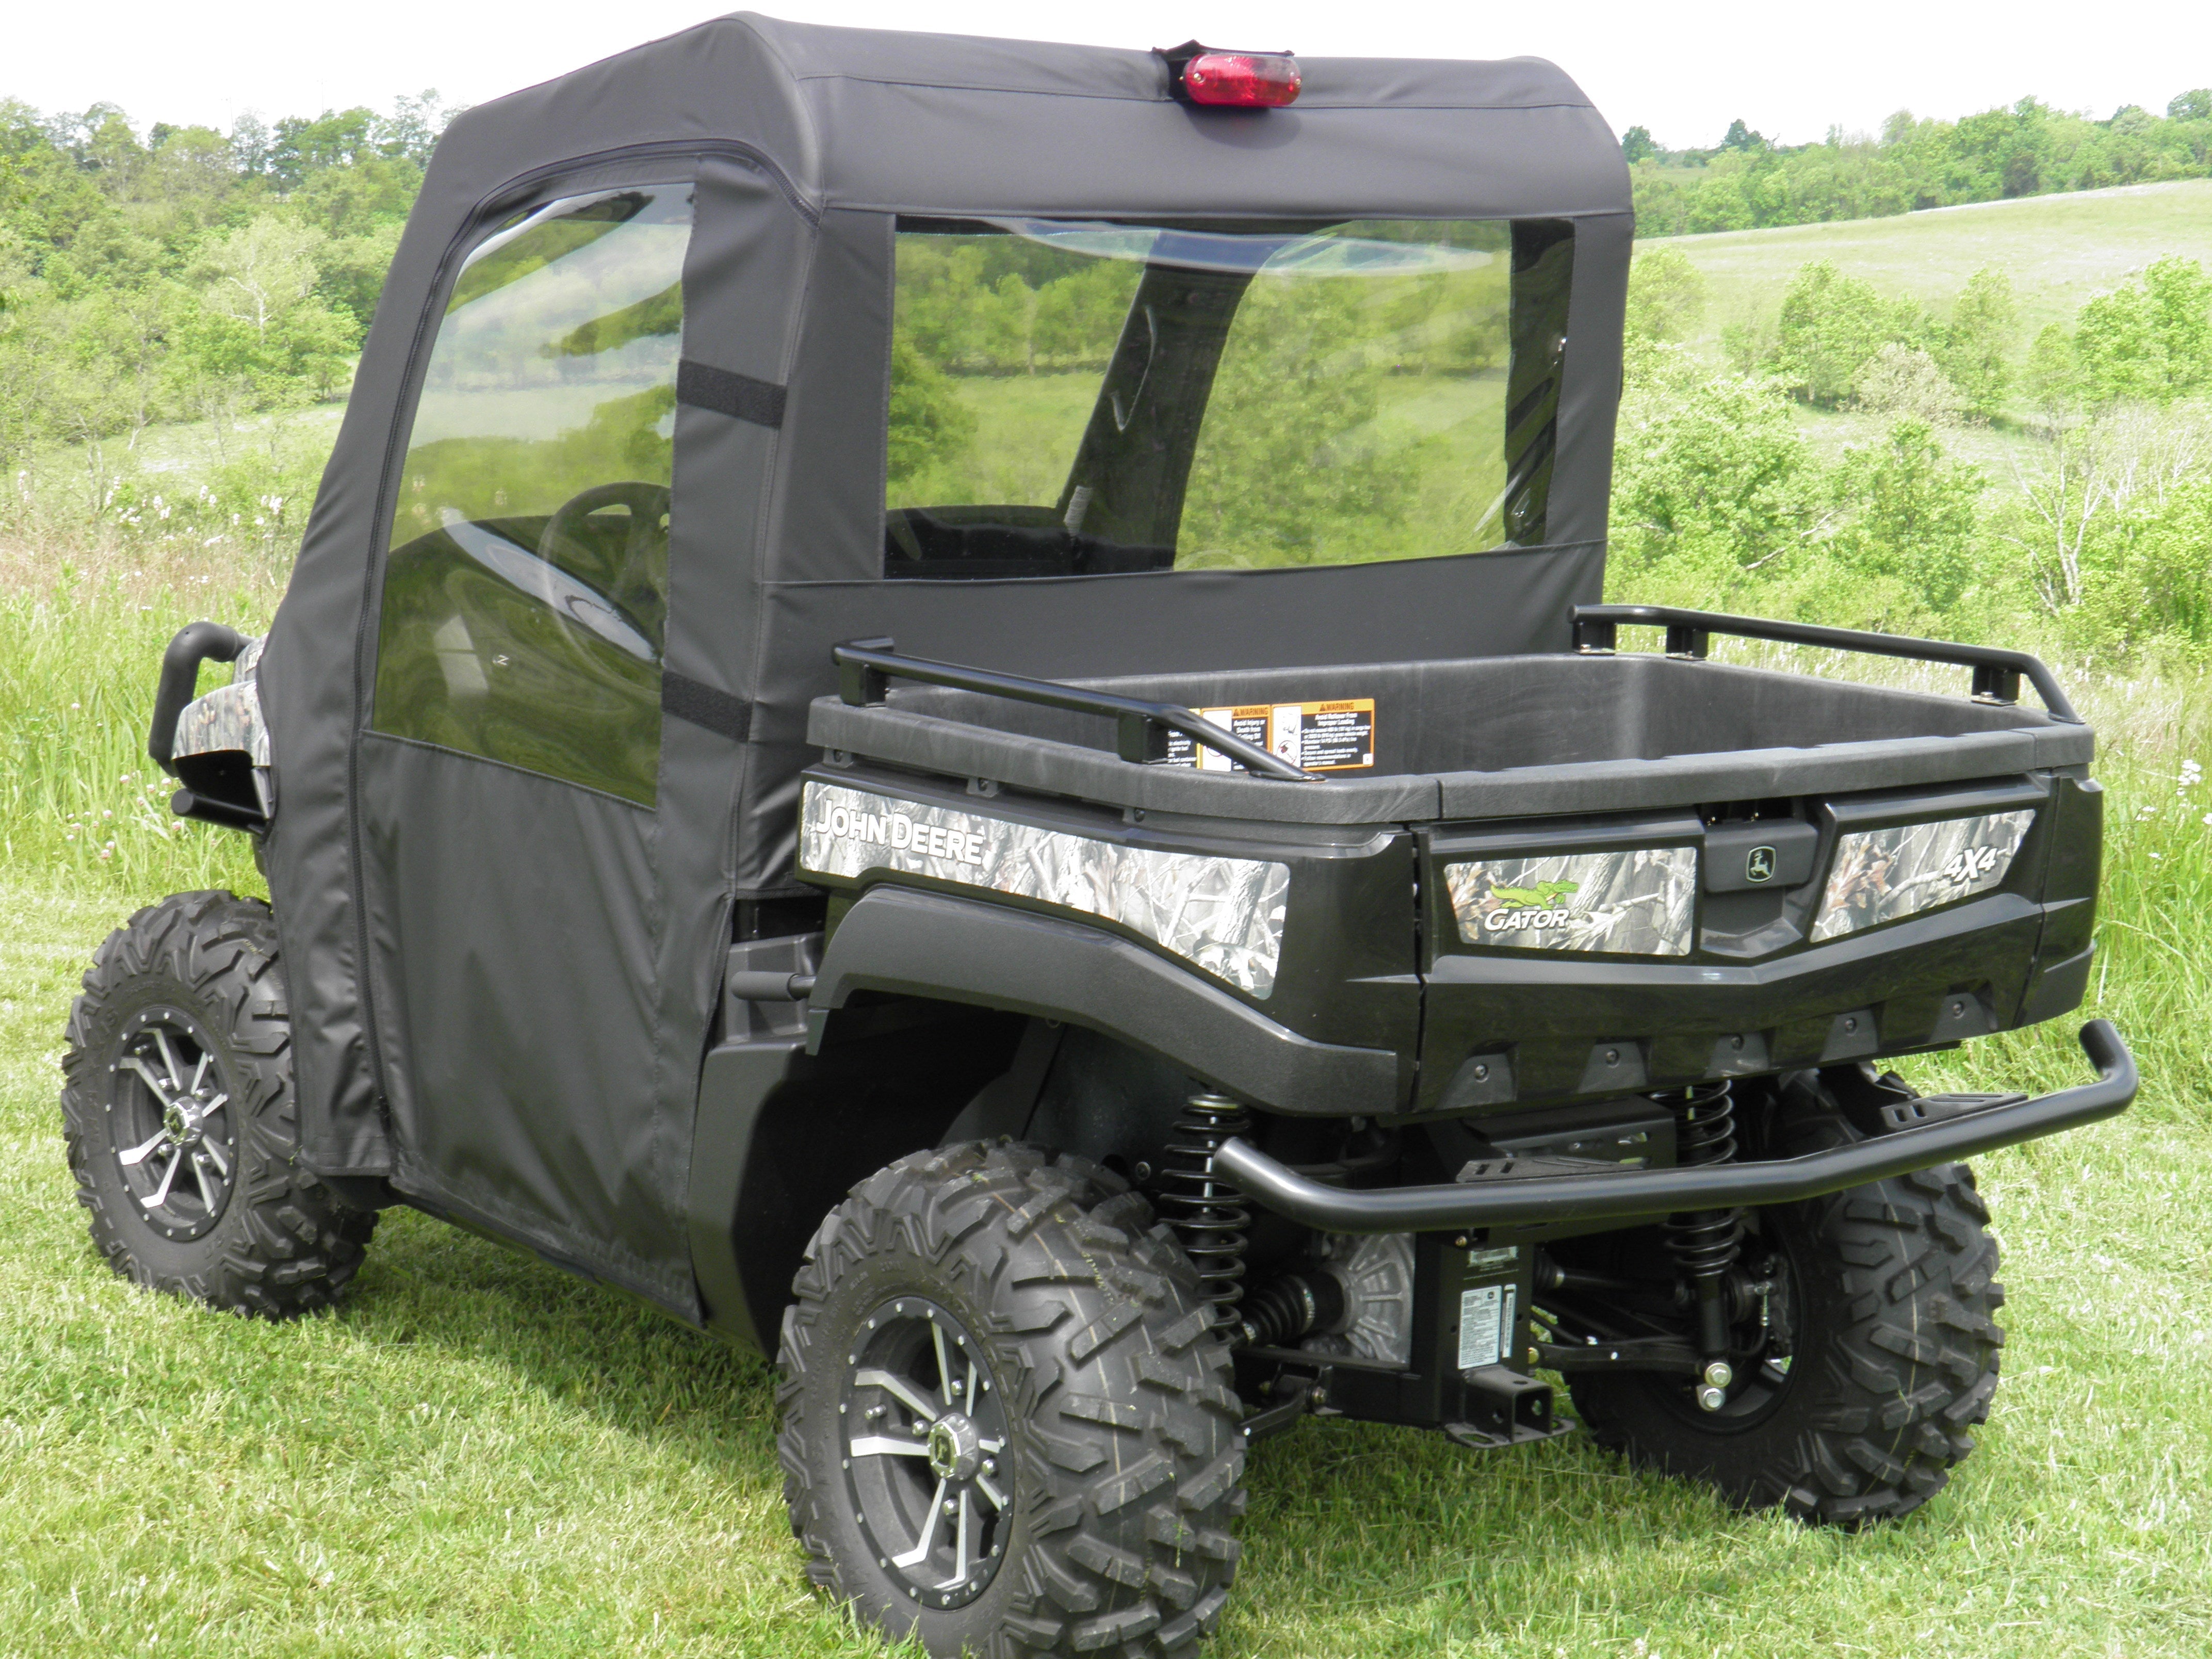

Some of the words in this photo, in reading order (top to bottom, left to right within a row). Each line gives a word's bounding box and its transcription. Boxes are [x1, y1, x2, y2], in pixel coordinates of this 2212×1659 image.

[1241, 707, 1268, 715] WARNING
[1326, 702, 1355, 710] WARNING
[817, 799, 887, 845] JOHN
[890, 811, 983, 865] DEERE
[1942, 845, 1997, 883] 4X4
[1484, 908, 1569, 932] GATOR
